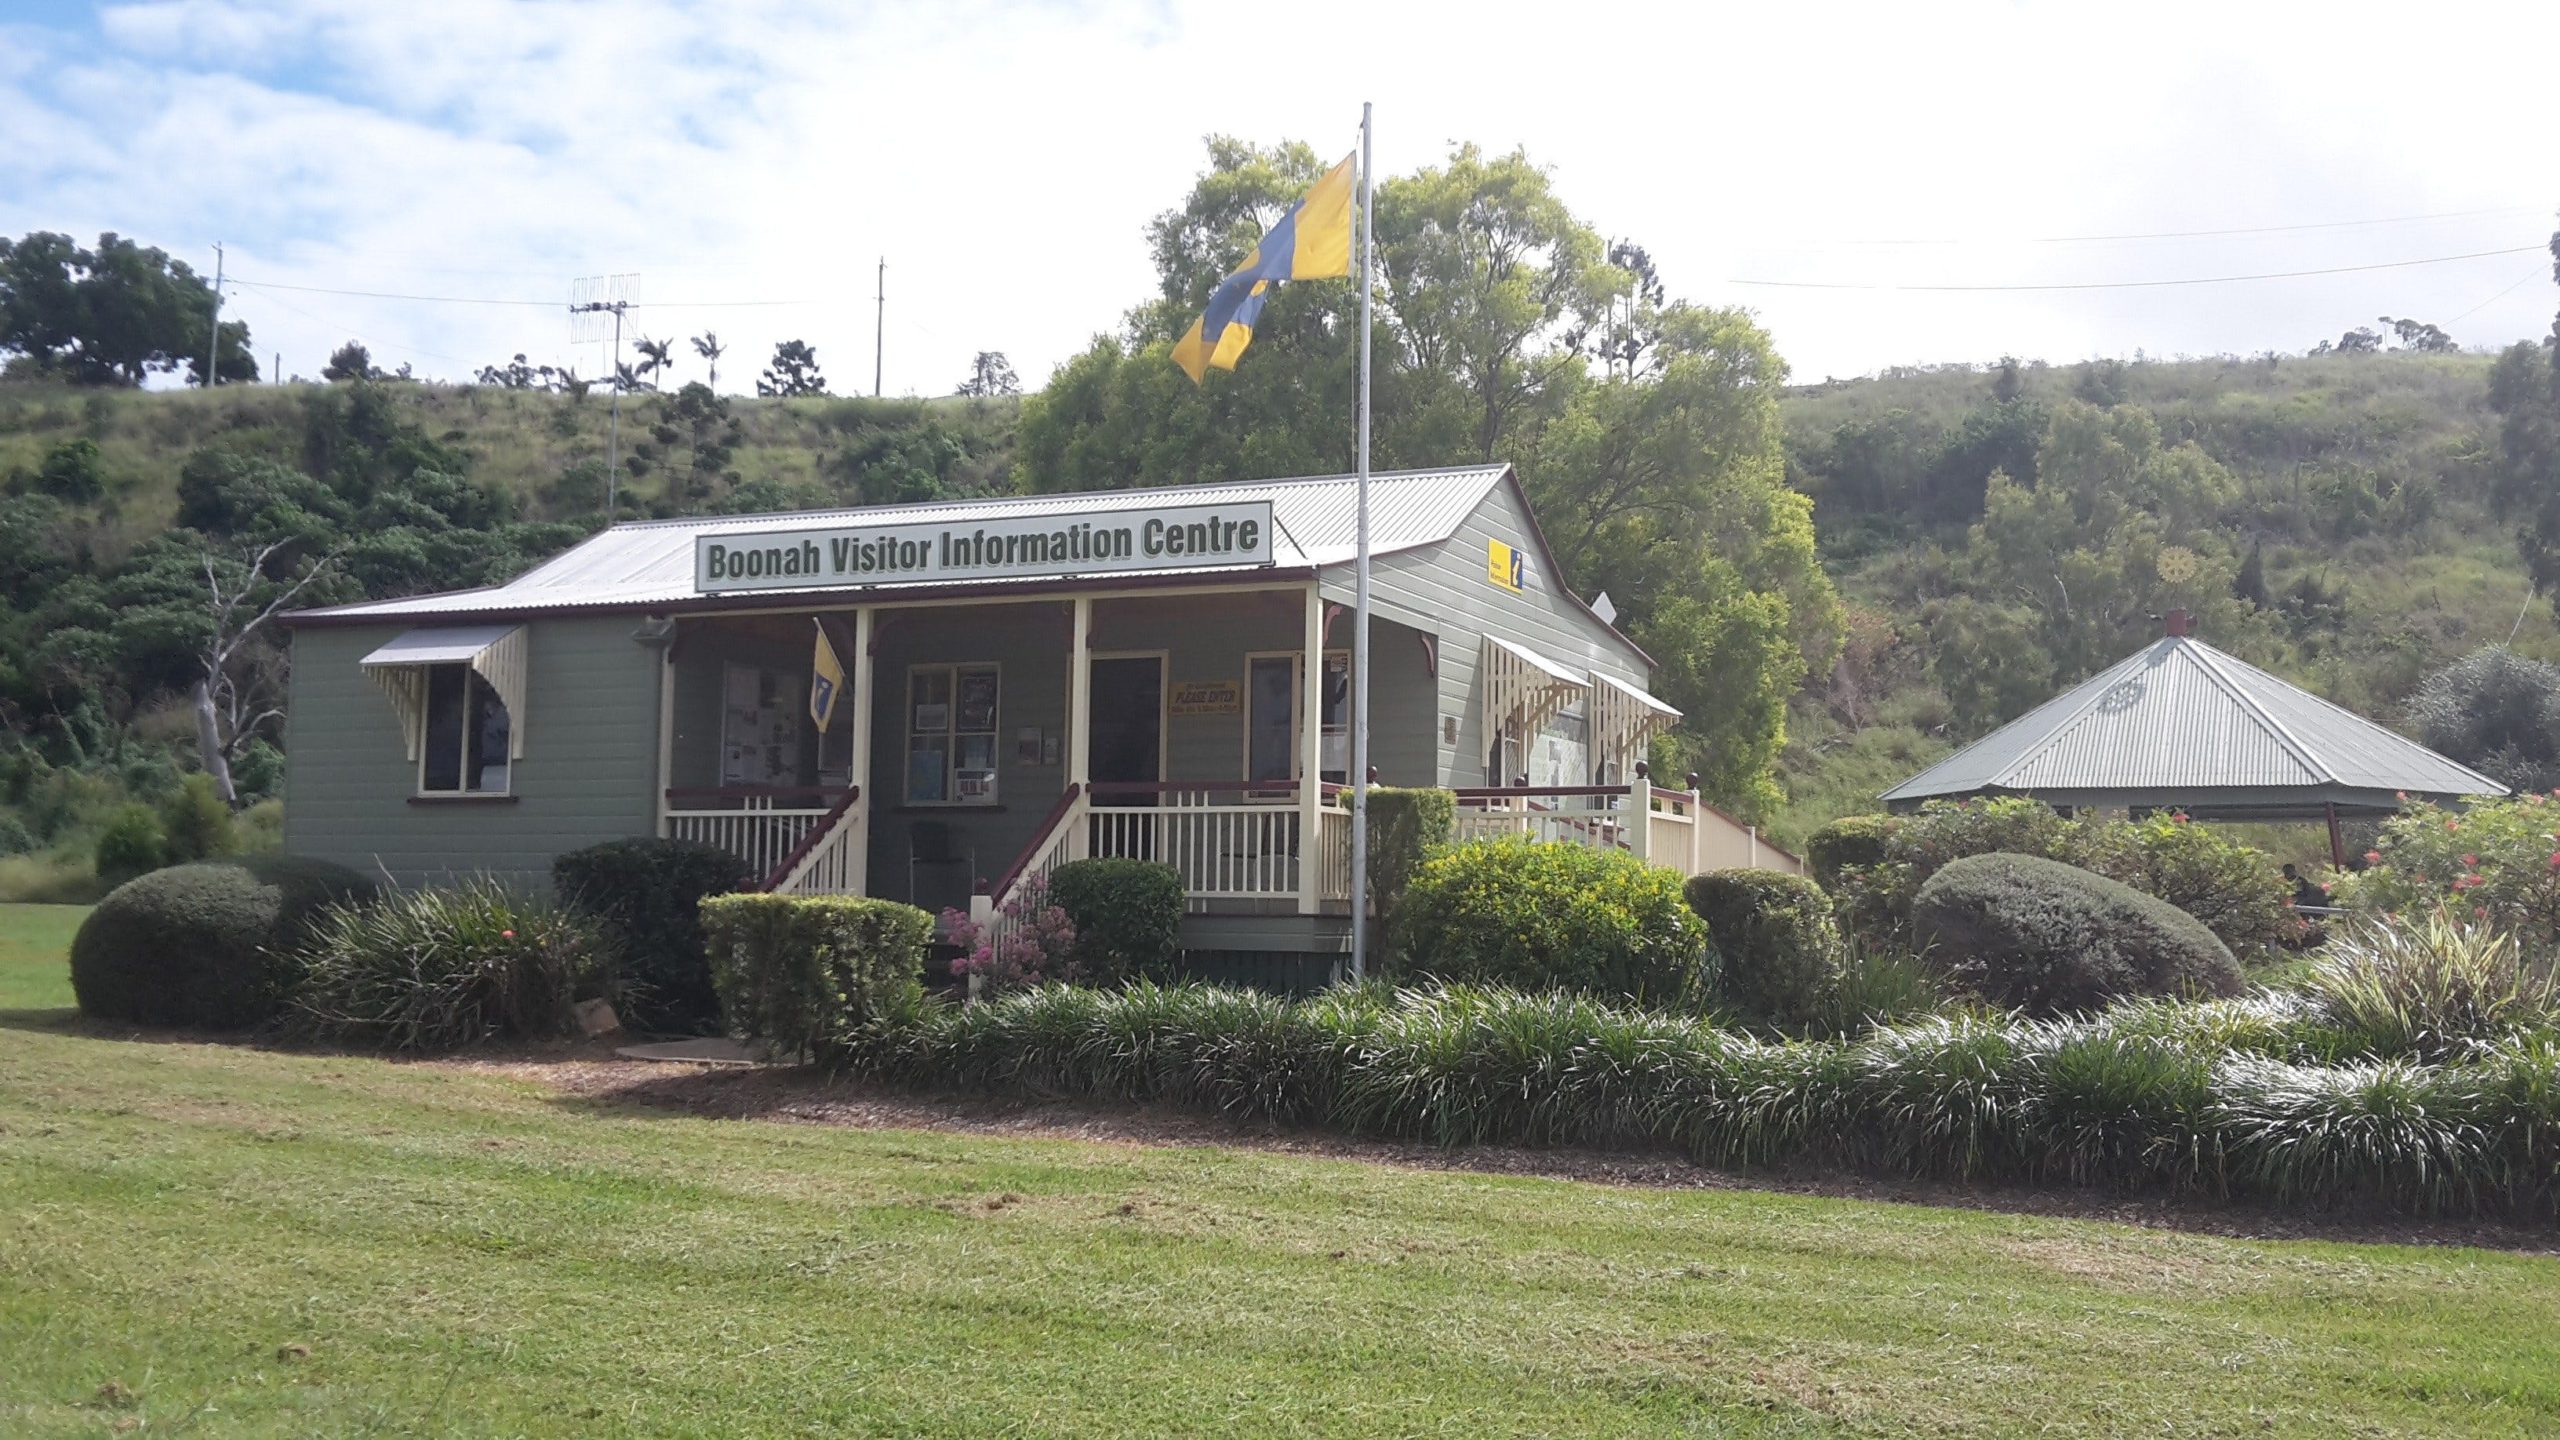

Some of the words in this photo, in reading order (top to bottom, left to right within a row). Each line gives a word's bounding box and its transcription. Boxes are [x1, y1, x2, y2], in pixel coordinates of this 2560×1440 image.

[707, 540, 820, 580] Boonah
[831, 536, 931, 574] Visitor
[940, 522, 1132, 568] Information
[1143, 516, 1259, 556] Centre
[1176, 691, 1207, 704] PLEASE
[1208, 689, 1236, 703] ENTER
